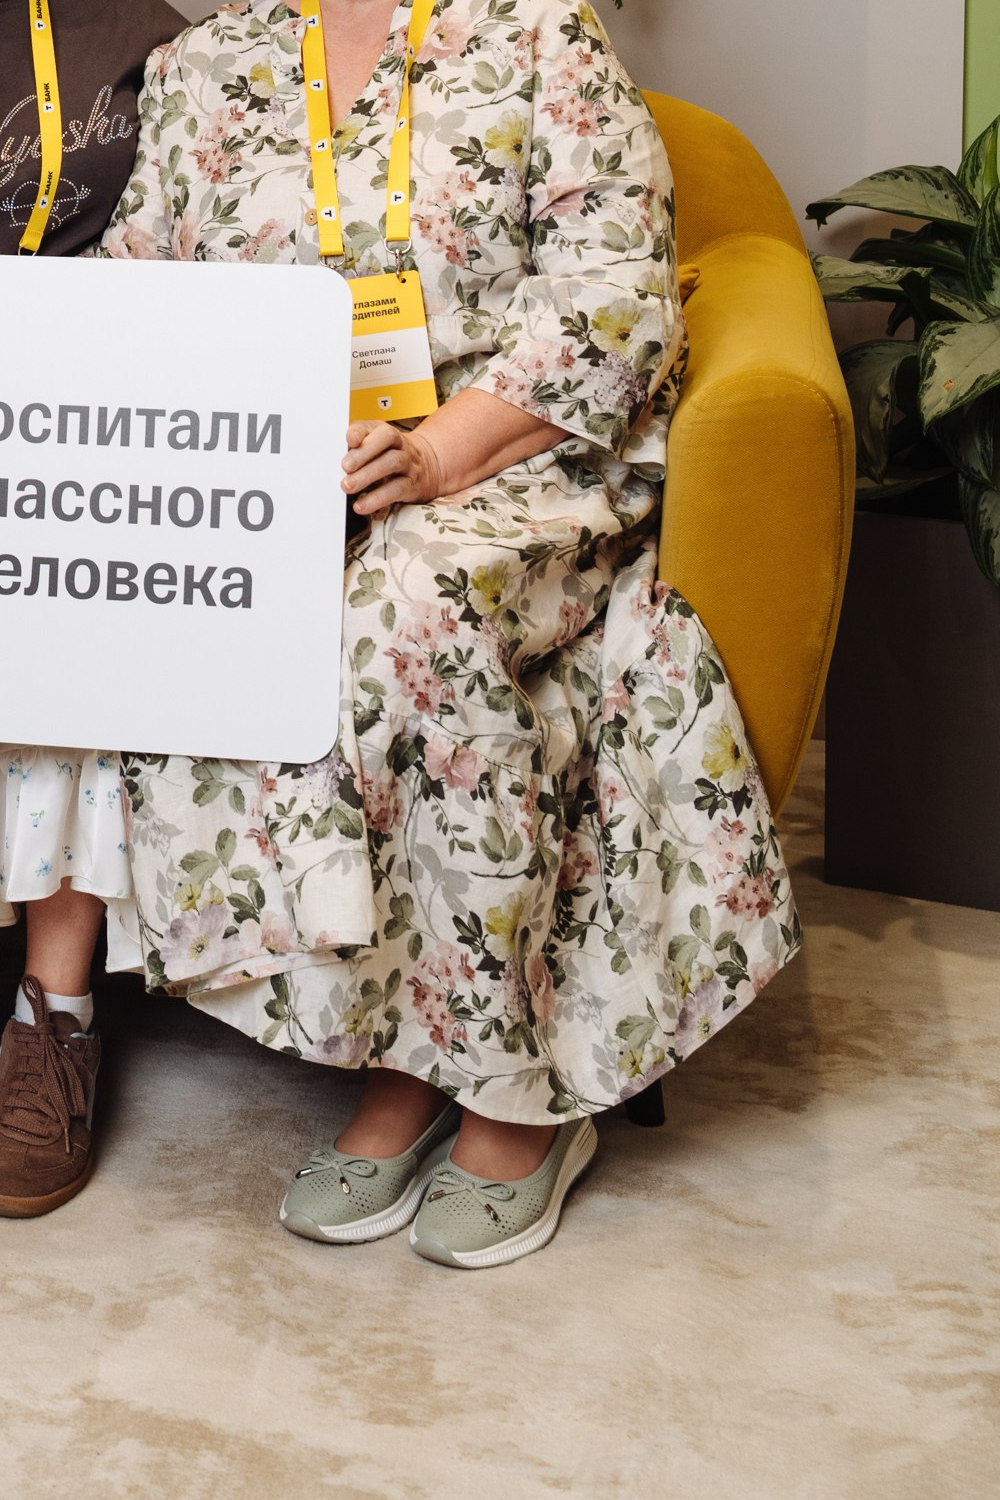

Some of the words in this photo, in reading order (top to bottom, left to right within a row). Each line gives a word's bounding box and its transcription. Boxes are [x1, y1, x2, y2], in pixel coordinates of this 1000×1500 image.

[44, 171, 53, 195] БАНК
[354, 297, 397, 309] глазами
[352, 306, 400, 320] одителей
[352, 346, 396, 359] Светлана
[359, 358, 392, 370] Домаш
